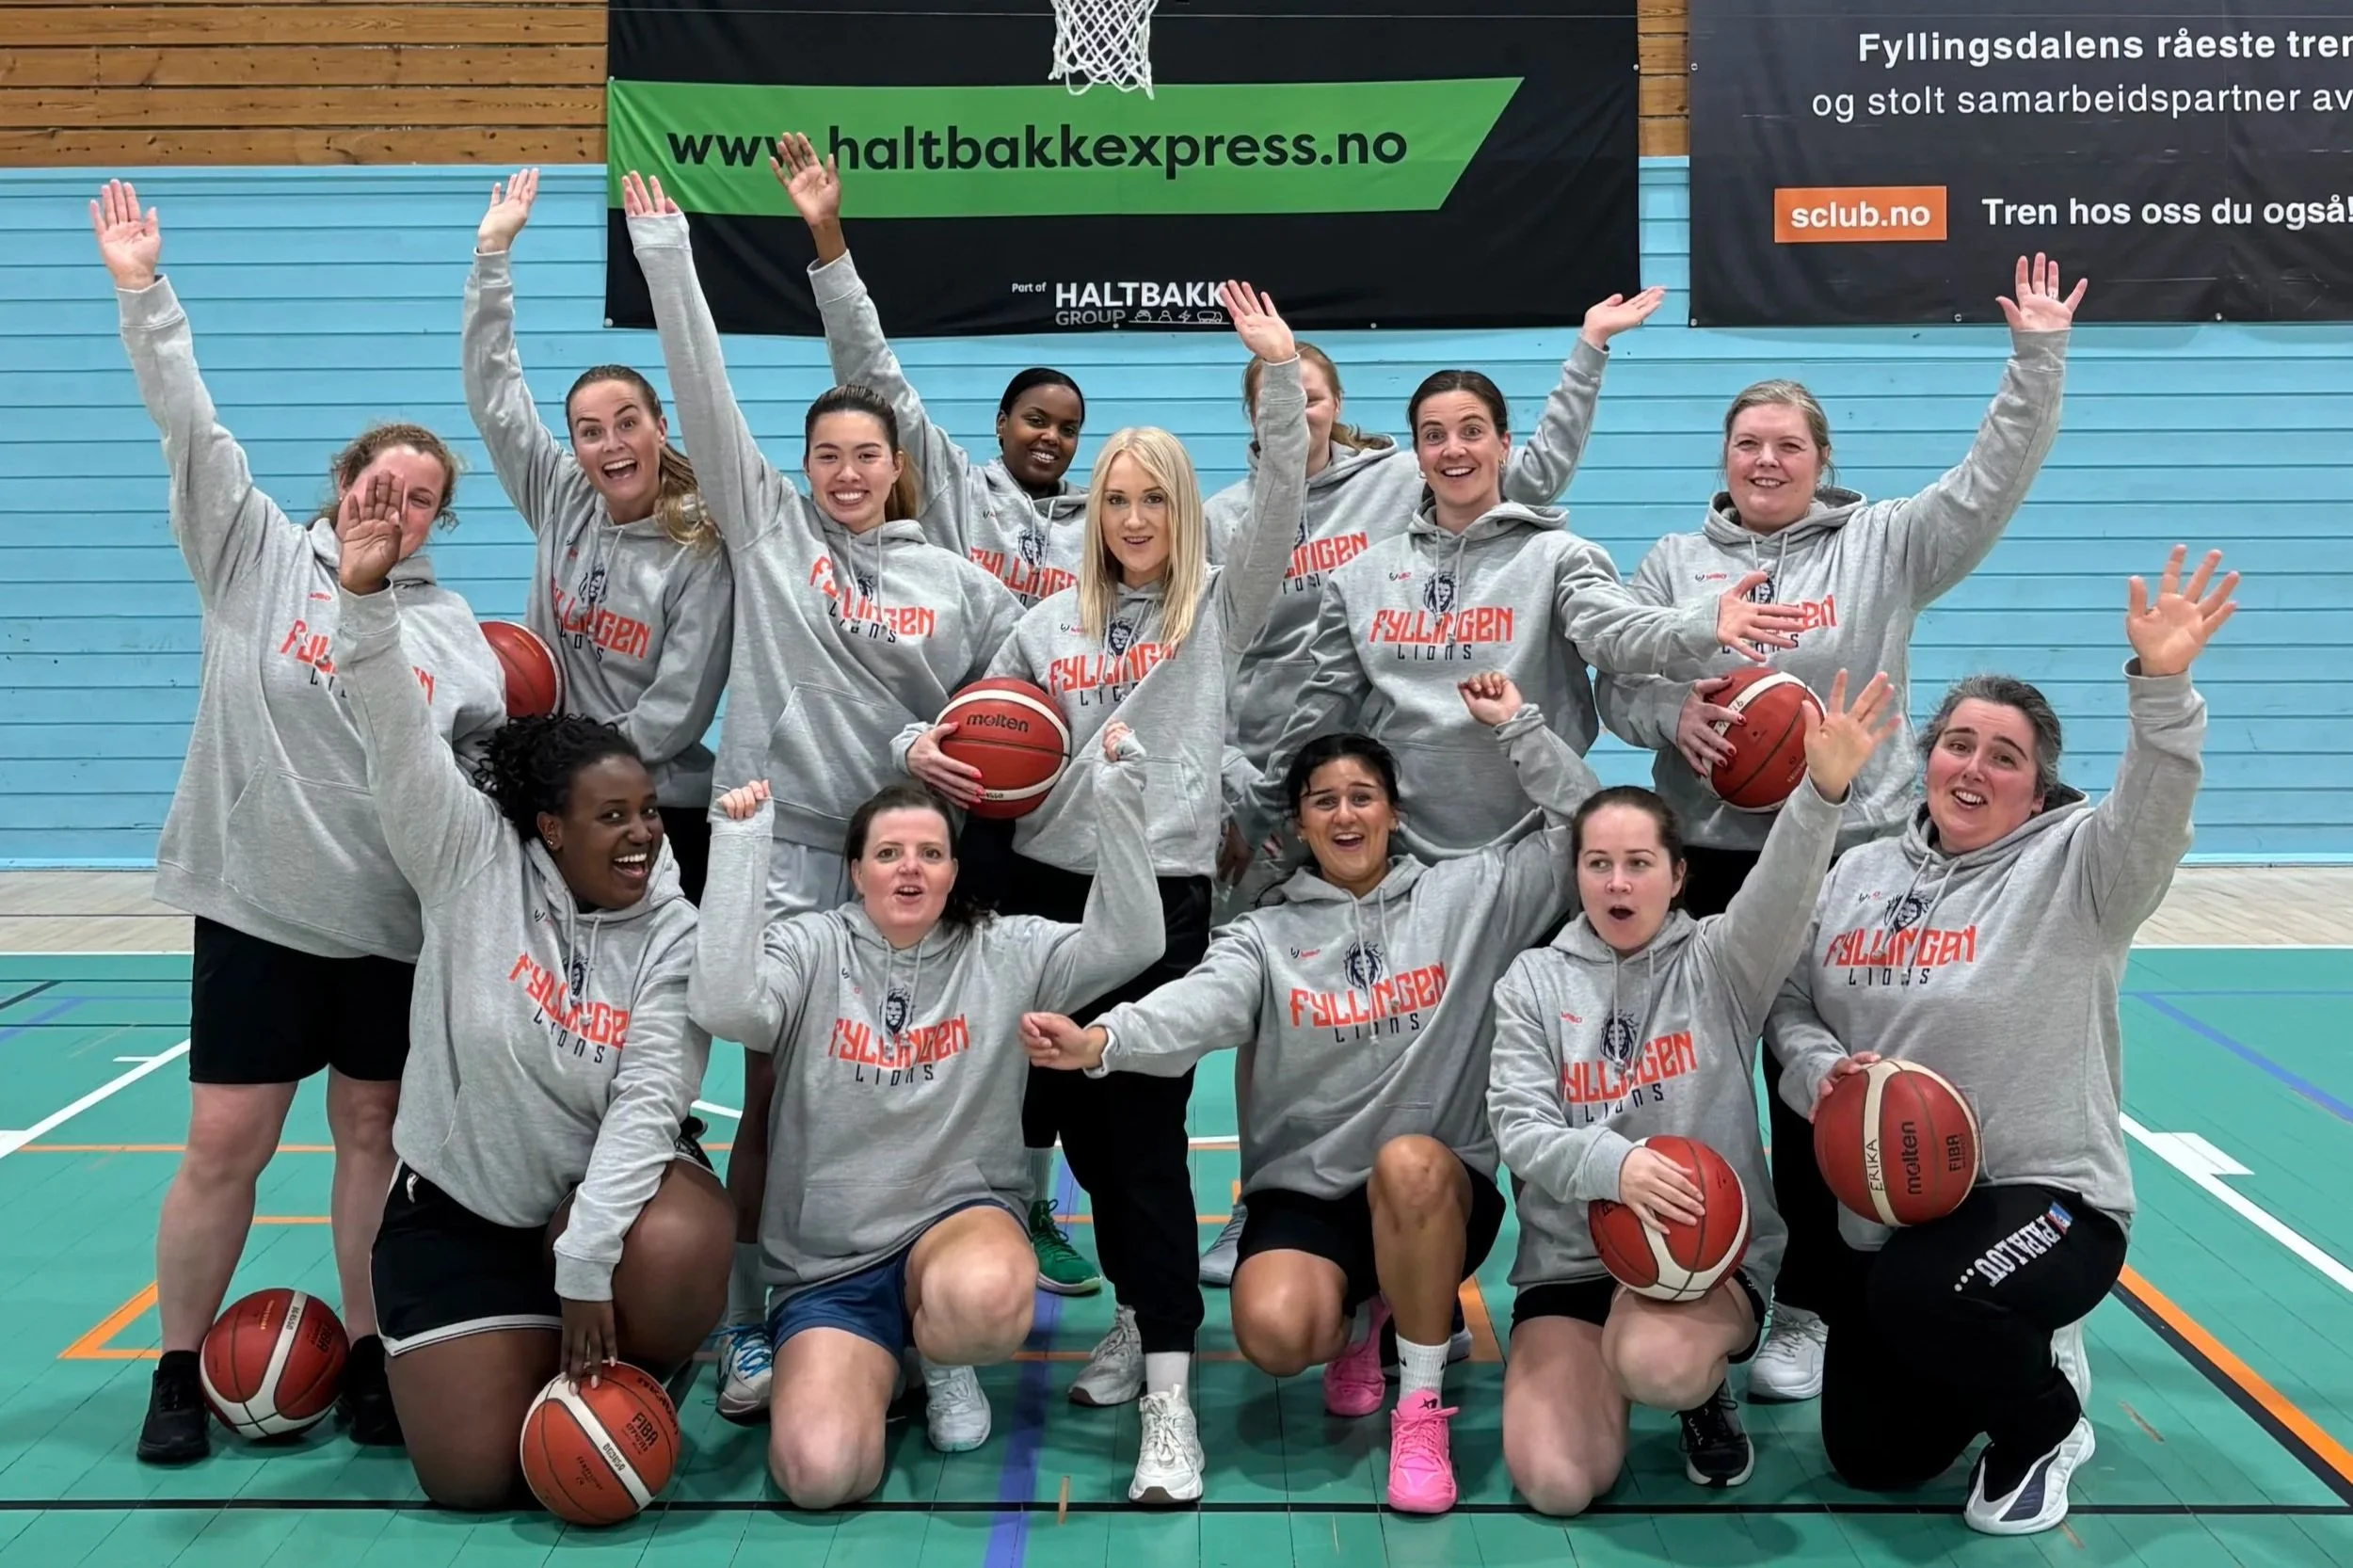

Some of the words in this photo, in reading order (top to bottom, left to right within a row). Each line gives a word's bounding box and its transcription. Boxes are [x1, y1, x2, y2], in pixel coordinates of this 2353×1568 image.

[1858, 30, 2144, 68] Fyllingsdalens
[2157, 29, 2276, 58] råeste
[1812, 91, 1856, 122] og
[1867, 86, 1945, 115] stolt
[1957, 84, 2300, 121] samarbeidspartner
[2312, 89, 2353, 112] av
[1790, 200, 1931, 229] sclub.no
[1981, 198, 2058, 226] Tren
[2070, 197, 2132, 226] hos
[2140, 202, 2202, 225] oss
[2211, 197, 2252, 225] du
[1012, 282, 1032, 294] Part
[1034, 281, 1047, 293] of
[1054, 281, 1228, 309] HALTBAKK
[1054, 309, 1126, 327] GROUP
[1397, 643, 1473, 661] LIONS
[966, 712, 1030, 734] molten
[506, 951, 632, 1052] FYLLINGE
[1865, 1138, 1886, 1192] ERIKA
[1899, 1120, 1924, 1195] molten
[1944, 1133, 1961, 1174] FIBA
[632, 1411, 660, 1449] FIBA
